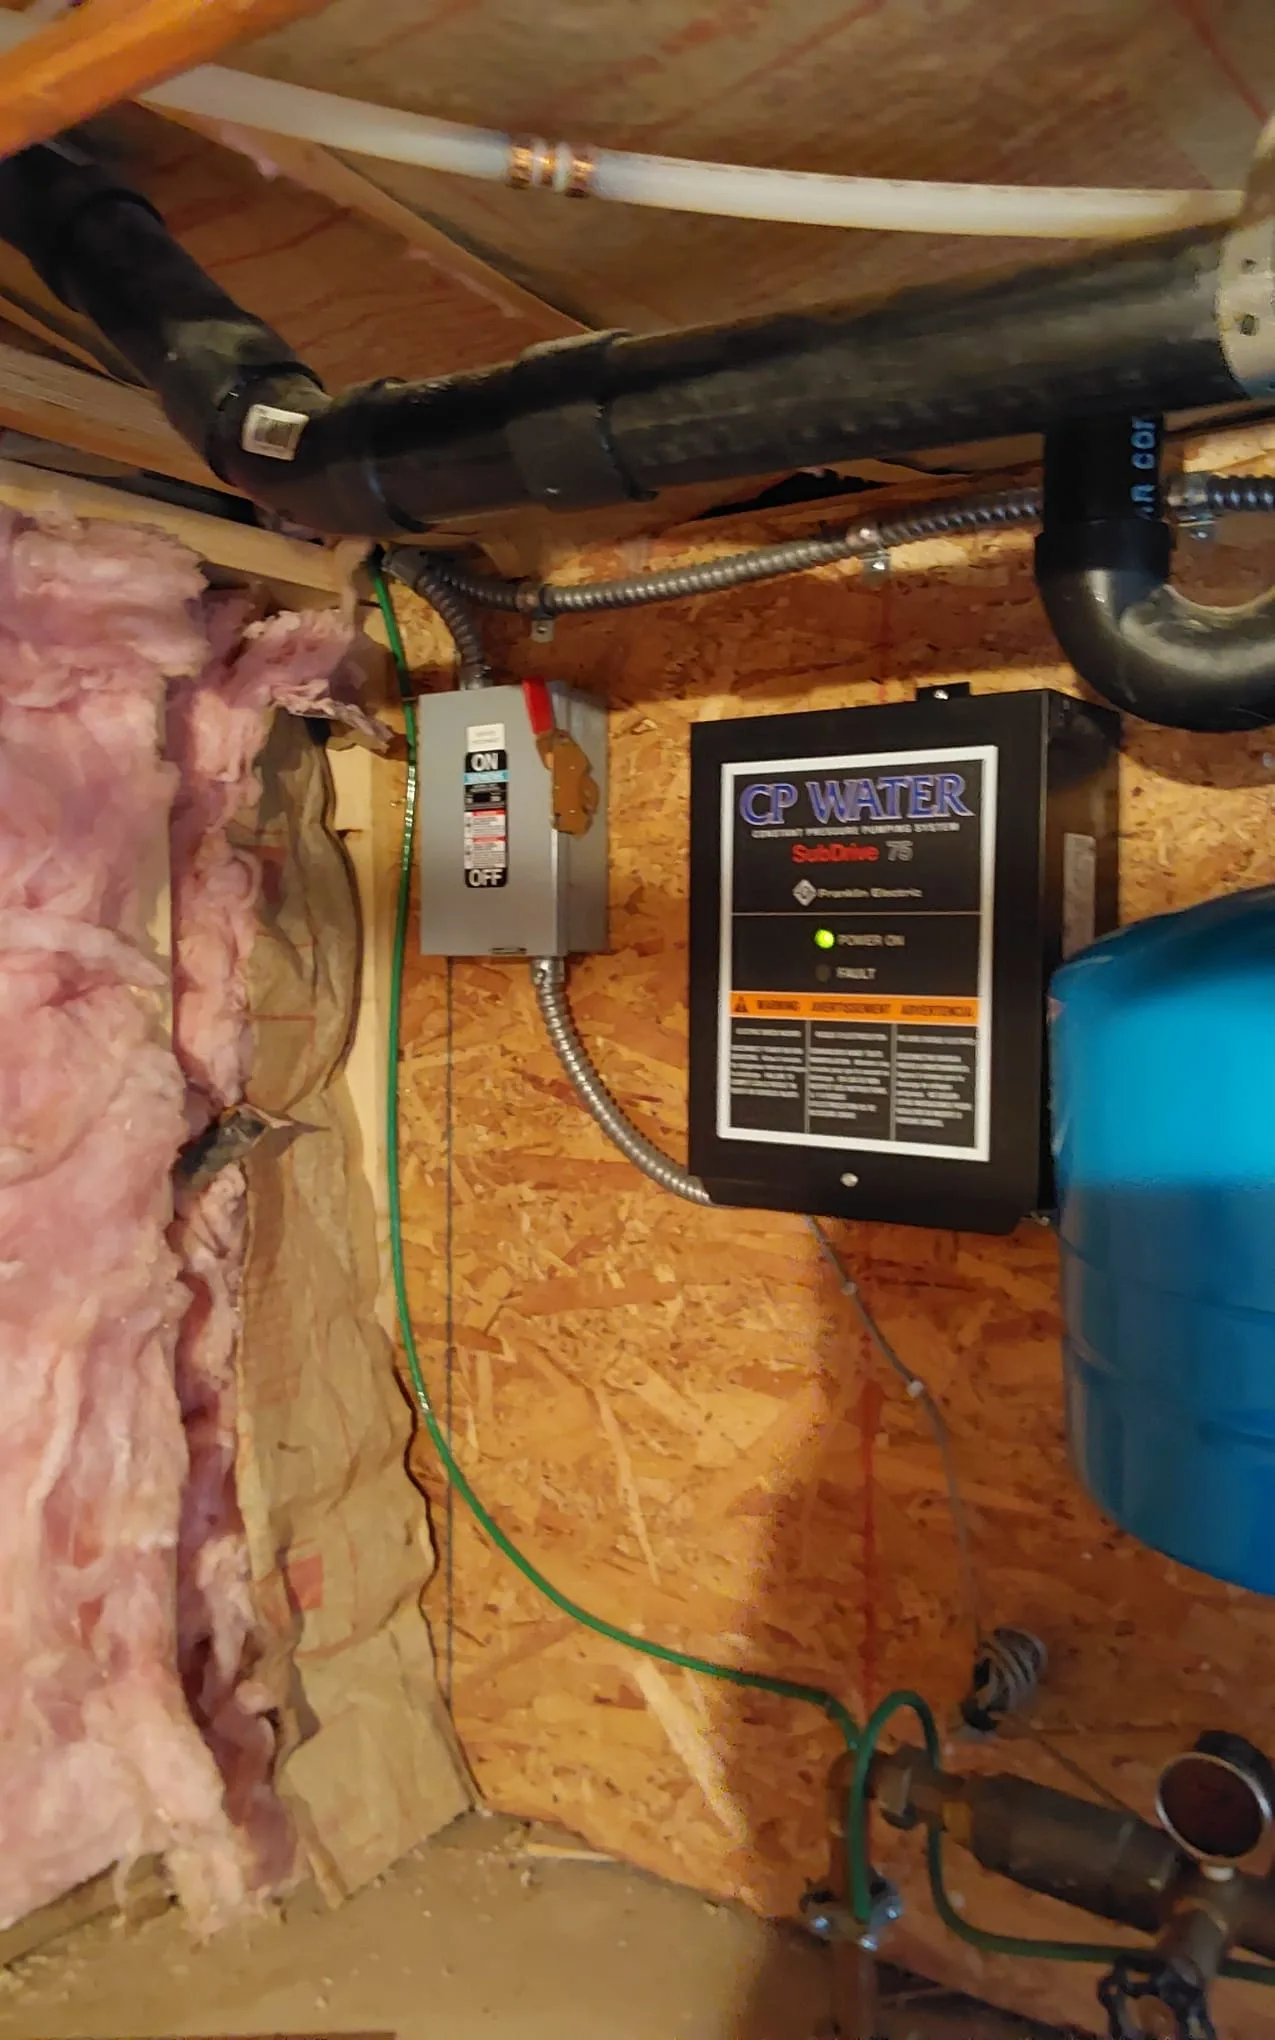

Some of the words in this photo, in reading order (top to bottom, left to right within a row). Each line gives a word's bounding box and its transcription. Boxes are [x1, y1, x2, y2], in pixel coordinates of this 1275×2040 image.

[470, 752, 499, 772] ON
[739, 782, 798, 826] CP
[805, 772, 976, 825] WATER
[792, 843, 880, 863] SubDrive
[885, 840, 914, 861] 75
[468, 869, 503, 887] OFF
[837, 934, 883, 947] POWER
[884, 934, 905, 947] ON
[836, 966, 877, 980] FAULT
